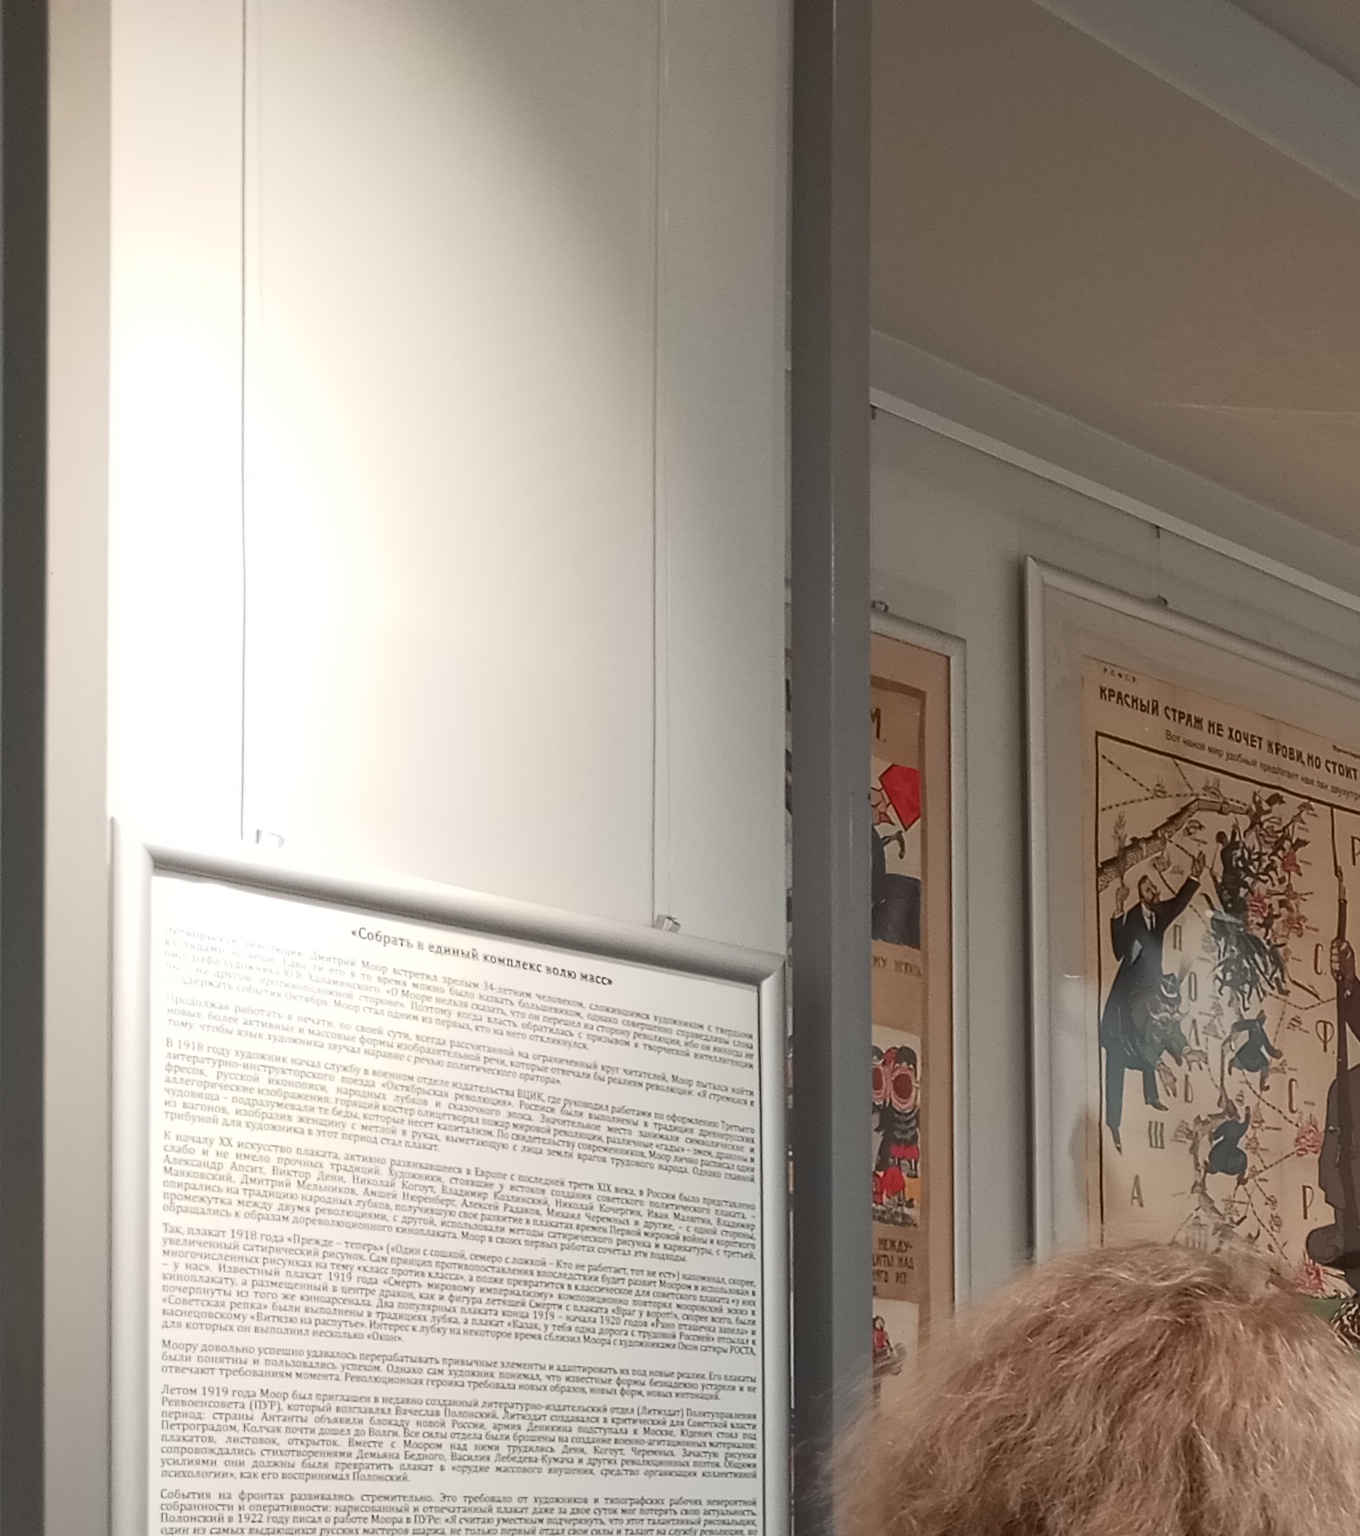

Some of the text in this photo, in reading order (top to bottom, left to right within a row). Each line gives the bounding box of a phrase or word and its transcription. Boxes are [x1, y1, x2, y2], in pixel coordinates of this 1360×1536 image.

[1099, 685, 1160, 717] КРАСНЫЙ
[1164, 705, 1204, 731] СТРАЖ
[1207, 719, 1224, 738] НЕ
[1227, 726, 1263, 750] ХОЧЕТ
[1307, 753, 1321, 770] НО
[1325, 759, 1358, 781] СТОИТ
[1165, 729, 1181, 743] Вот
[1207, 745, 1224, 758] мир
[1225, 750, 1258, 767] удобный
[350, 925, 613, 987] «Собрать единый комплекс волю масс»
[178, 1038, 231, 1058] 1918 году
[166, 1050, 376, 1089] литературно-инструкторского поезда
[216, 1067, 260, 1086] русской
[164, 1107, 242, 1129] трибуной для
[234, 1105, 293, 1125] изобразив
[163, 1140, 271, 1164] слабо имело
[176, 1132, 293, 1157] началу искусство
[164, 1152, 224, 1172] Александр
[163, 1178, 298, 1203] опирались традицию
[239, 1172, 291, 1191] Дмитрий
[163, 1190, 273, 1212] промежутка между
[186, 1225, 227, 1238] плакат
[162, 1233, 319, 1260] увеличенный сатирический
[162, 1247, 313, 1271] многочисленных рисунках
[162, 1283, 278, 1300] почерпнуты того
[162, 1307, 298, 1324] васнецовскому «Витязю
[161, 1319, 310, 1337] для которых выполнил
[161, 1350, 248, 1366] были понятны
[162, 1338, 305, 1359] Моору довольно успешно
[161, 1364, 293, 1381] отвечают требованиям
[161, 1383, 257, 1400] Летом 1919 года
[161, 1395, 245, 1410] Реввоенсовета
[286, 1400, 332, 1415] который
[211, 1411, 254, 1424] страны
[260, 1411, 308, 1423] Антанты
[242, 1422, 282, 1434] Колчак
[284, 1425, 316, 1435] почти
[160, 1445, 257, 1458] сопровождались
[160, 1457, 295, 1470] усилиями они должны
[160, 1488, 284, 1503] События фронтах
[160, 1500, 234, 1514] собранности
[161, 1511, 290, 1526] Полонский 1922 году
